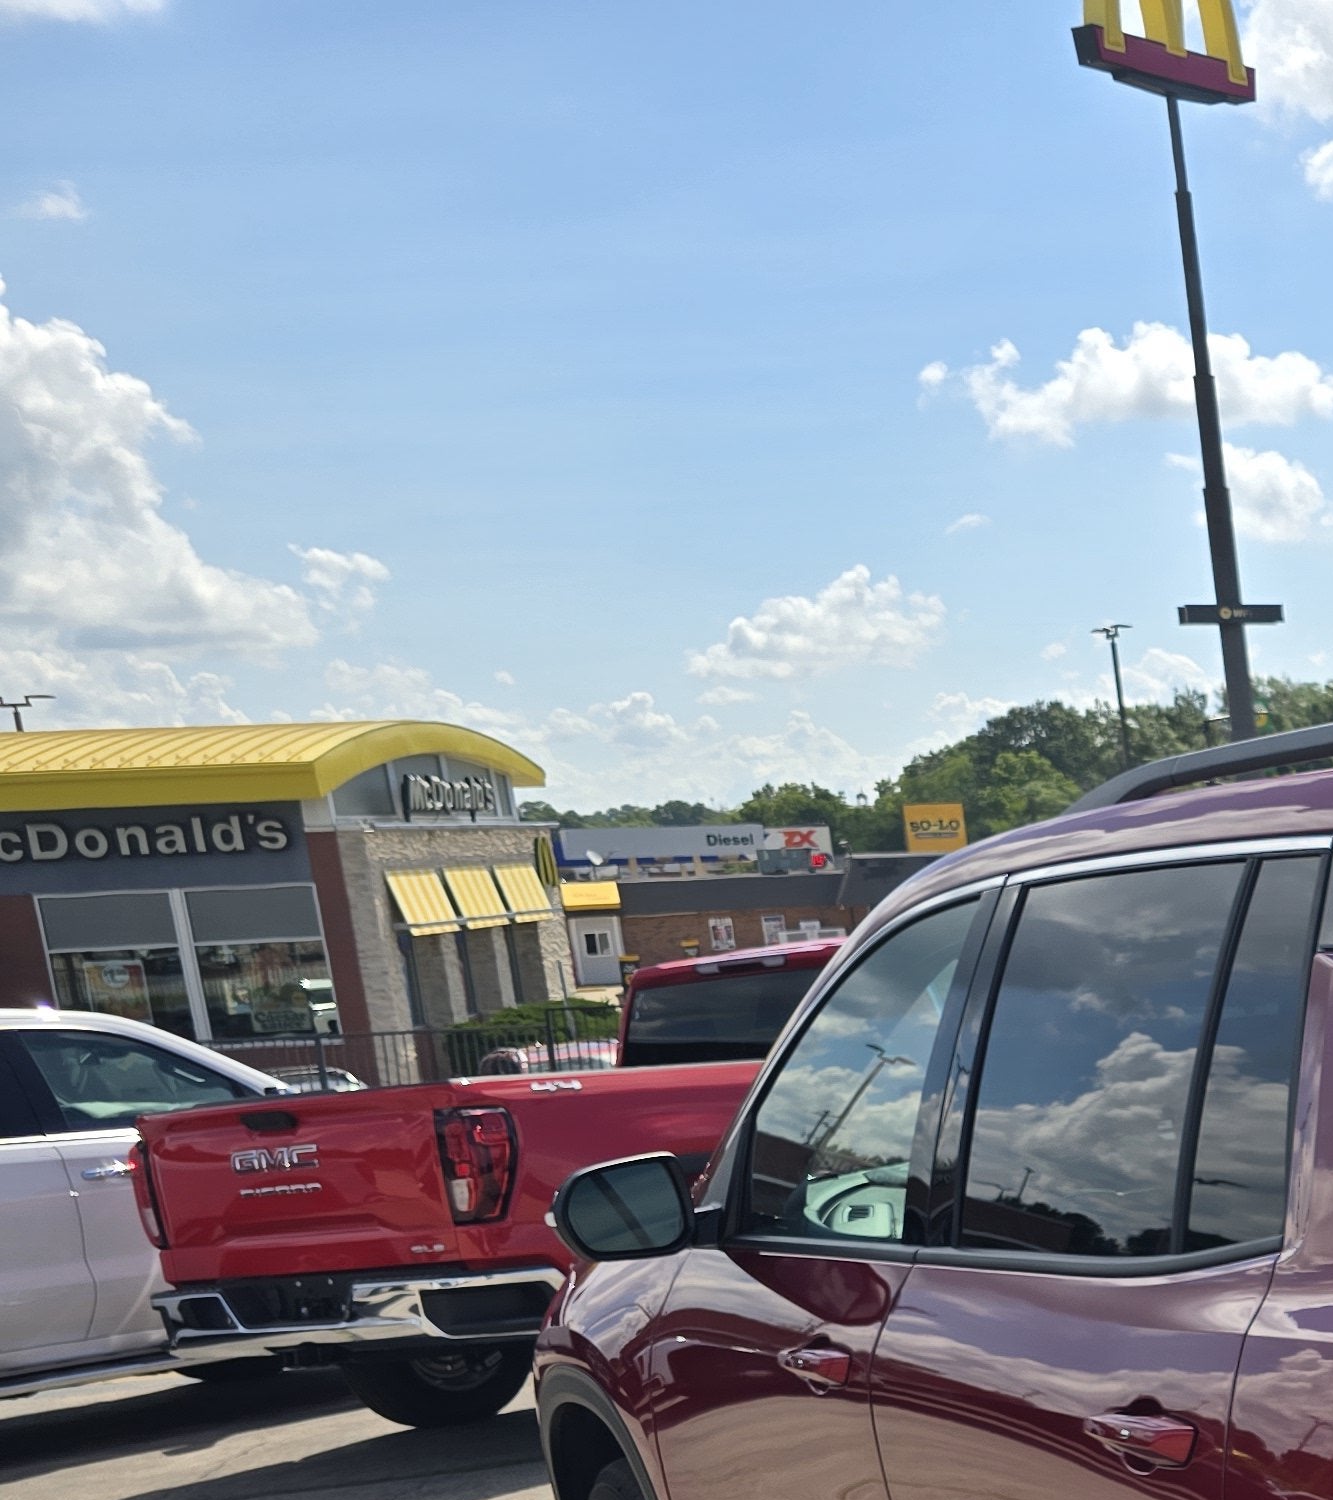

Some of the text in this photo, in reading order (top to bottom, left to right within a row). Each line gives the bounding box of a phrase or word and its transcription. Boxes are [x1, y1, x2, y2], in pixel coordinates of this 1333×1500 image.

[403, 774, 495, 812] McDonald's
[0, 815, 288, 862] cDonald's
[706, 833, 754, 847] Diesel
[910, 819, 961, 832] SO-LO
[231, 1143, 319, 1173] GMC
